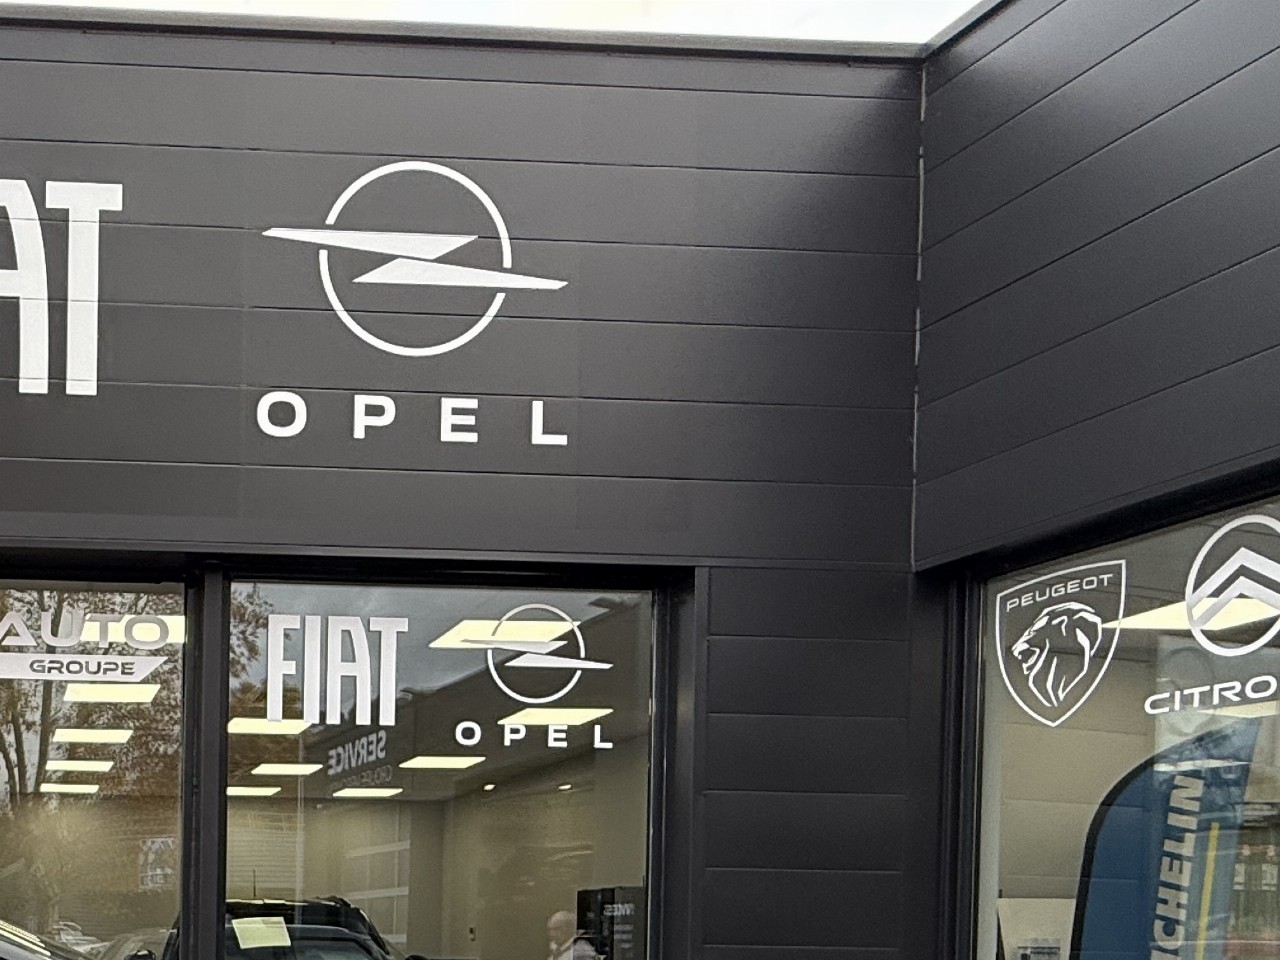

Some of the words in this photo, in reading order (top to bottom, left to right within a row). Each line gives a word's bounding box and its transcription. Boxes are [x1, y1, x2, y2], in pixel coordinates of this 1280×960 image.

[256, 391, 568, 446] OPEL
[1006, 574, 1113, 612] PEUGEOT
[29, 659, 135, 676] GROUPE
[266, 614, 409, 726] FIAT
[454, 720, 614, 749] OPEL
